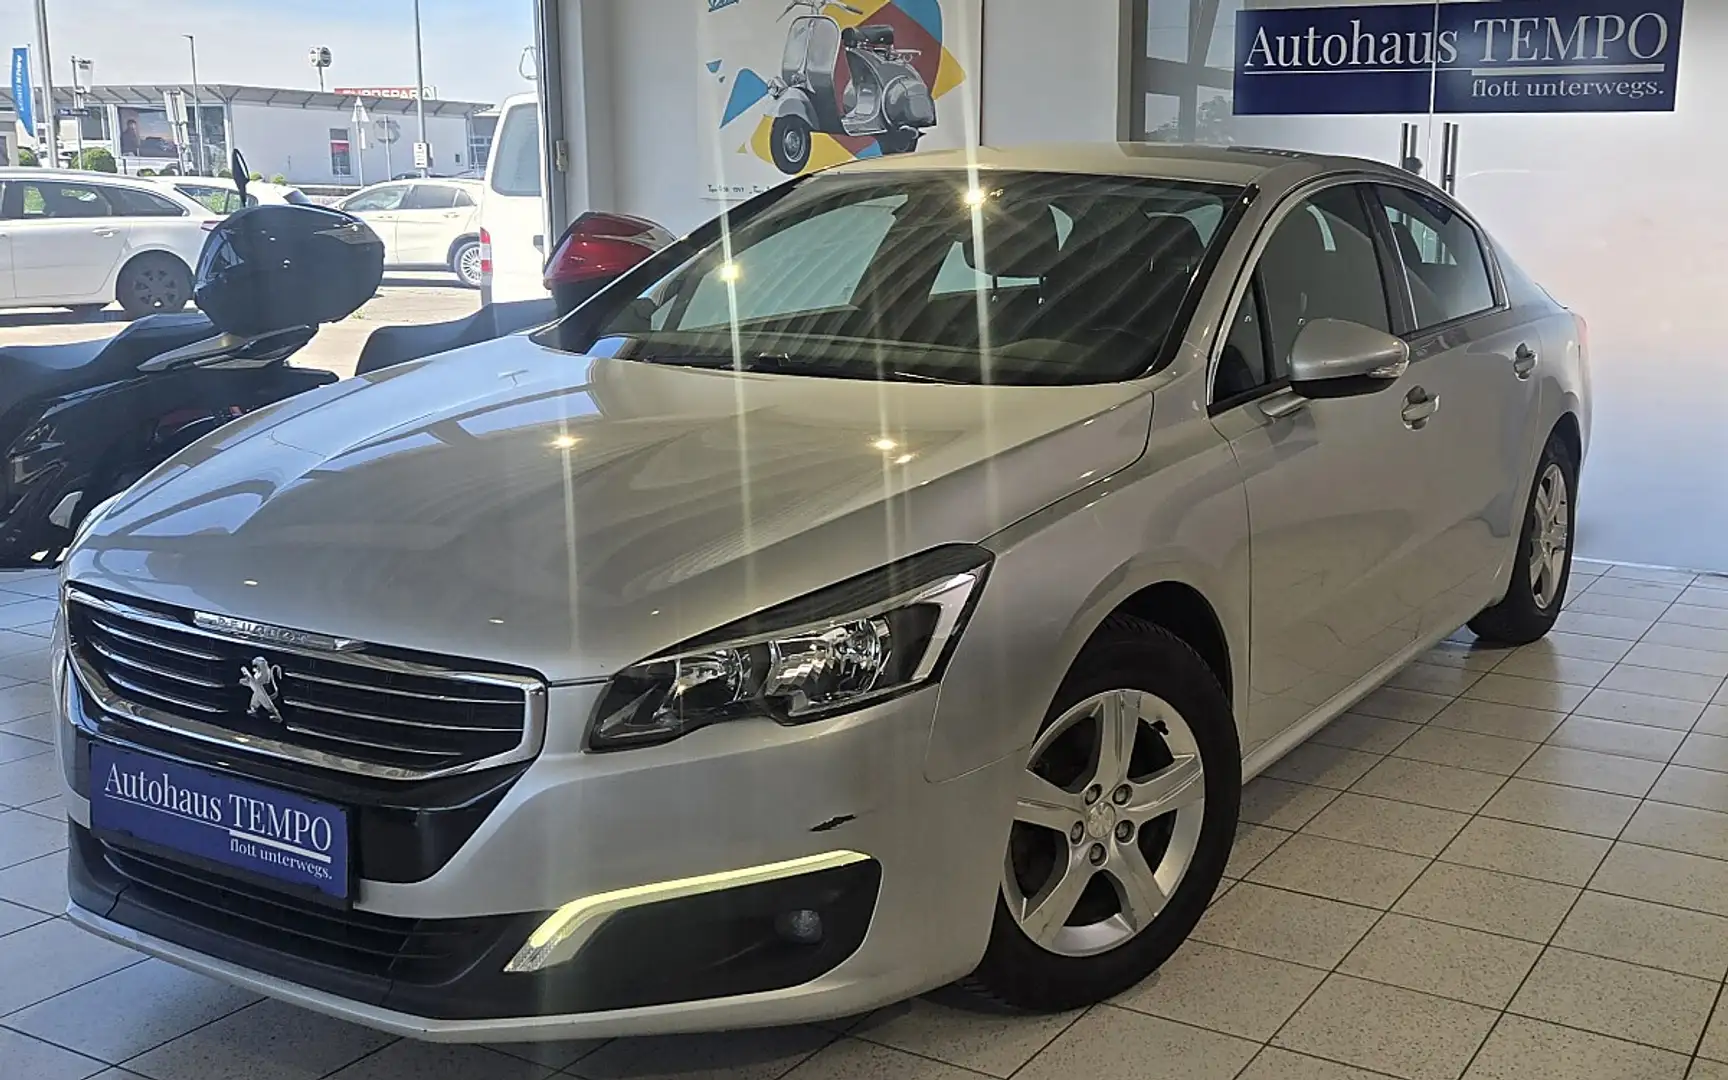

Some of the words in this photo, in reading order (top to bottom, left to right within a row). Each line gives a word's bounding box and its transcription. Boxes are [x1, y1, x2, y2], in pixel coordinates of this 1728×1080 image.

[1244, 20, 1458, 68] Autohaus
[1474, 12, 1669, 62] TEMPO
[1471, 79, 1521, 98] flott
[1525, 80, 1665, 98] unterwegs.
[105, 763, 222, 822] Autohaus
[229, 793, 332, 851] TEMPO
[229, 838, 257, 856] flott
[259, 846, 333, 880] unterwegs.
